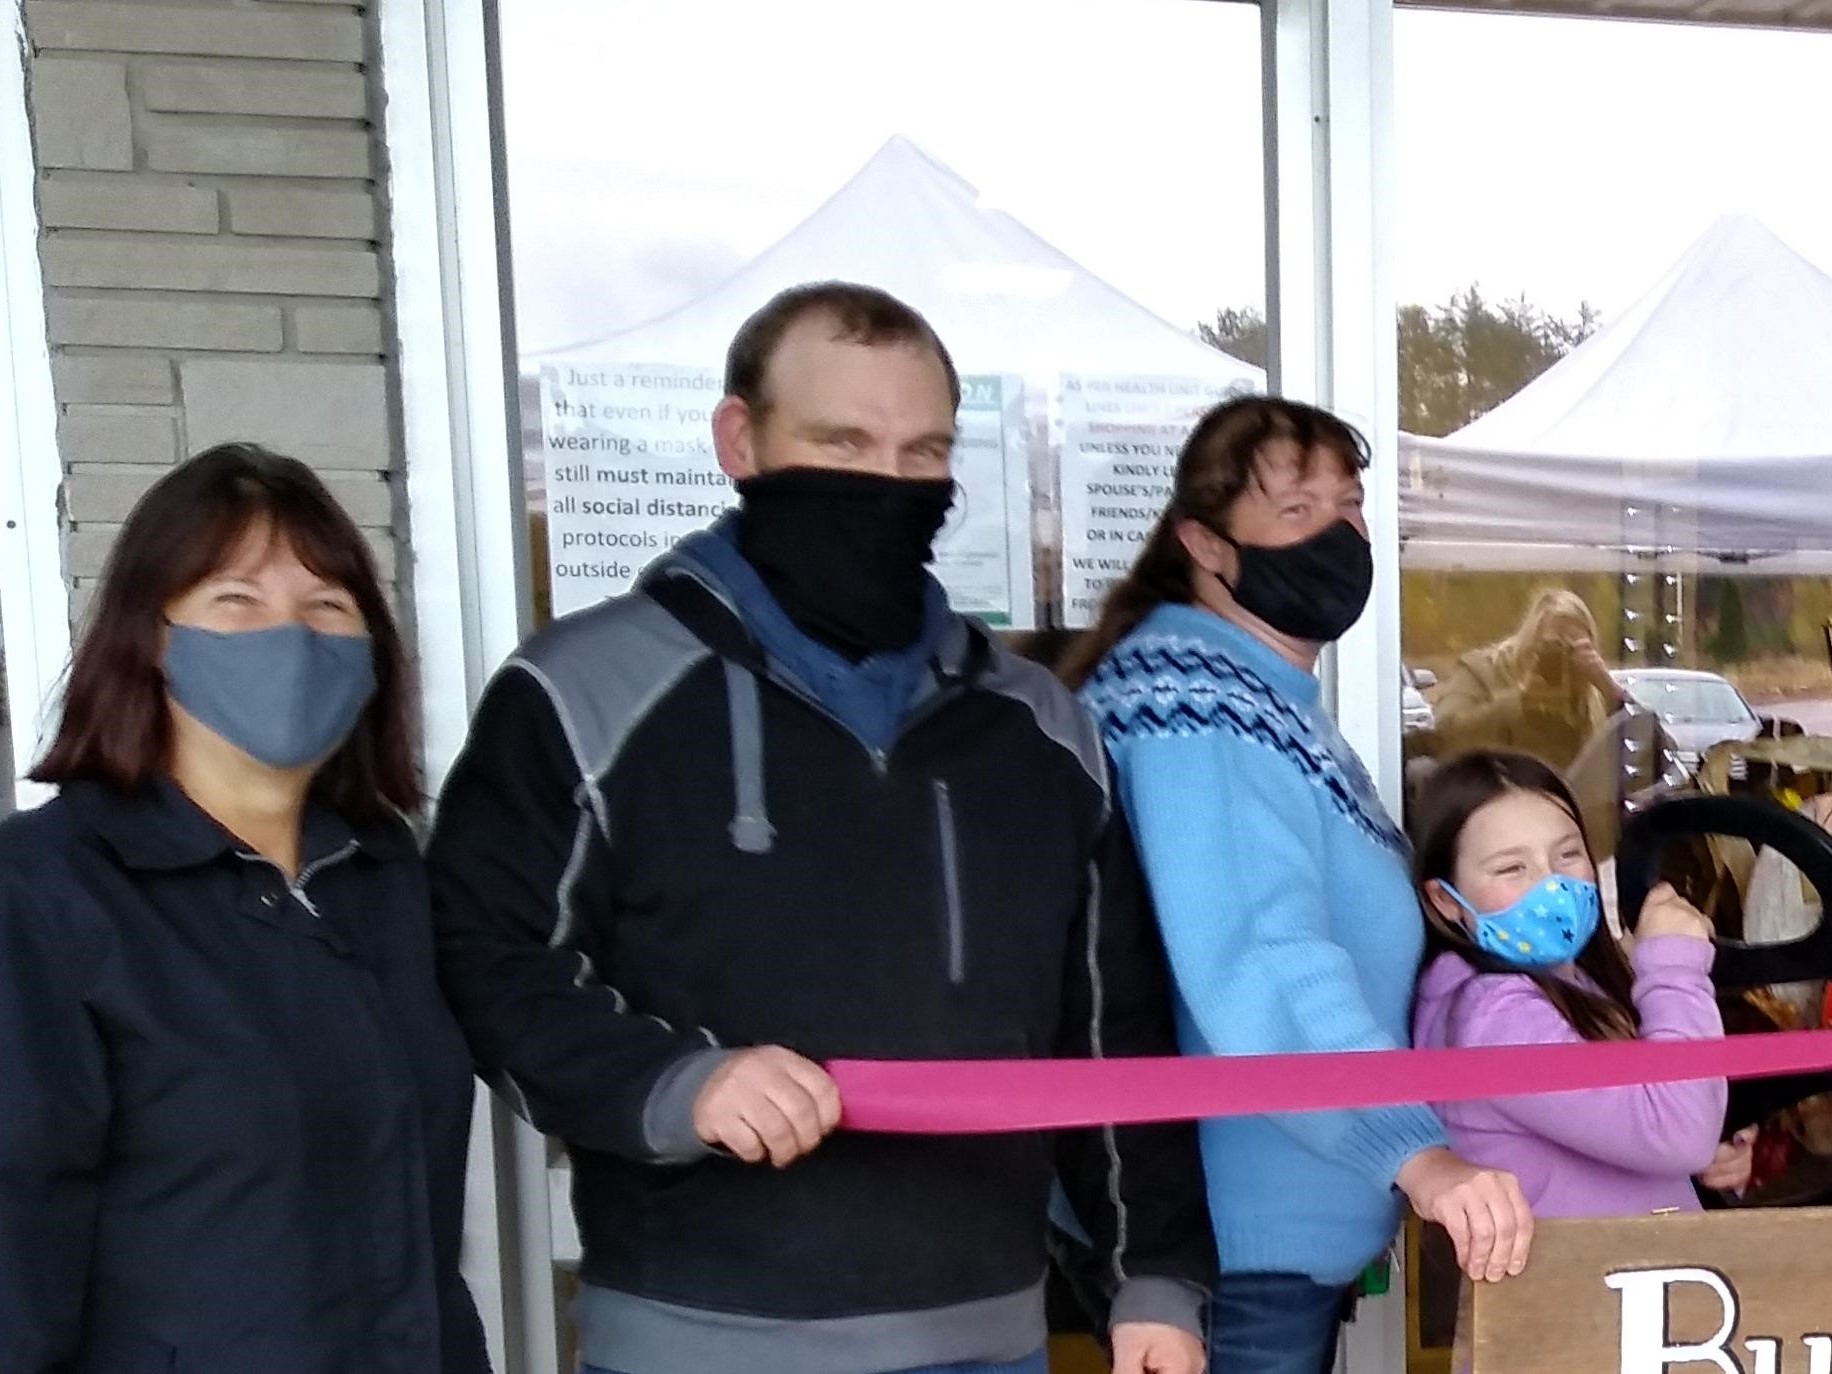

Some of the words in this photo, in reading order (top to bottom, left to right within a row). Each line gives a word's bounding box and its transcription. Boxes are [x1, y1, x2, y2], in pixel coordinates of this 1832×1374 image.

[567, 369, 608, 387] Just
[613, 372, 625, 387] a
[555, 399, 596, 419] that
[603, 405, 651, 420] even
[657, 403, 671, 420] if
[549, 433, 631, 456] wearing
[637, 438, 648, 452] a
[555, 464, 591, 482] still
[597, 468, 649, 484] must
[655, 469, 739, 487] maintai
[1112, 463, 1160, 477] KINDLY
[553, 497, 576, 514] all
[582, 500, 640, 516] social
[646, 499, 725, 518] distanci
[562, 530, 658, 549] protocols
[1086, 528, 1106, 541] OR
[1109, 529, 1124, 541] IN
[555, 560, 631, 579] outside
[1072, 557, 1094, 570] WE
